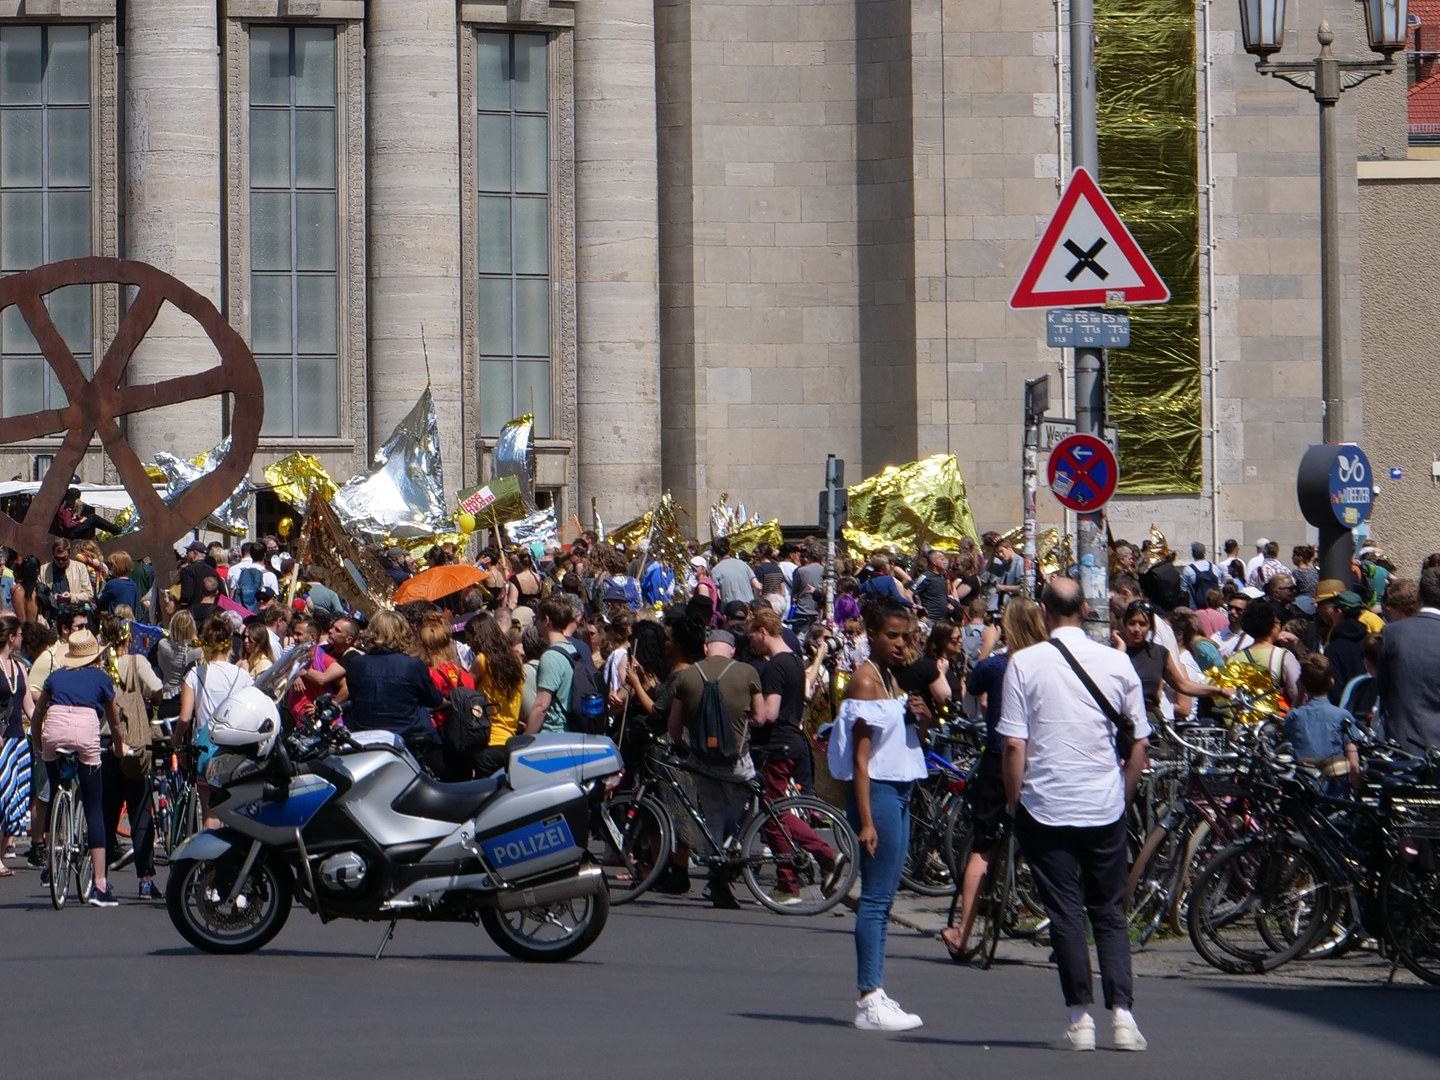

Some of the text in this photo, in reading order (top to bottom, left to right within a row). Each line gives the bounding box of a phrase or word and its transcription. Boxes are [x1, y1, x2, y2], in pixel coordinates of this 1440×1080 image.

[1075, 314, 1088, 323] ES
[1103, 314, 1115, 323] ES
[493, 827, 567, 864] POLIZEI
